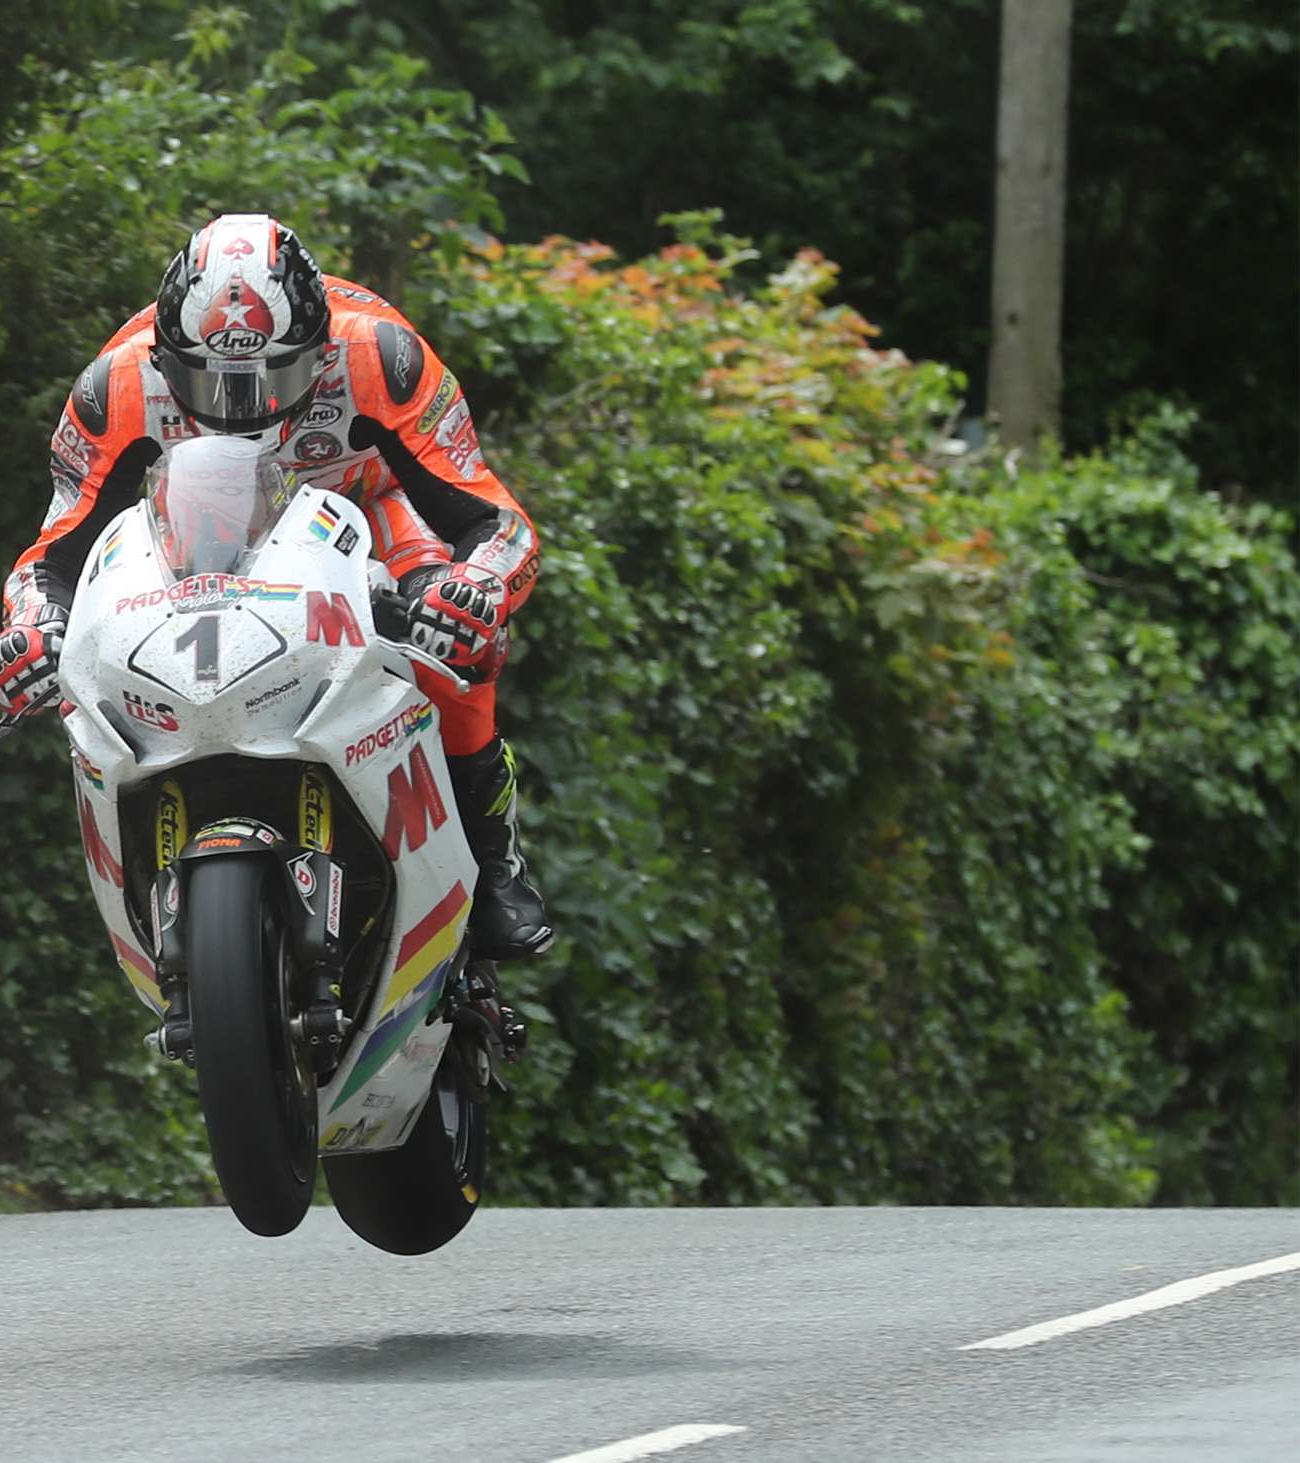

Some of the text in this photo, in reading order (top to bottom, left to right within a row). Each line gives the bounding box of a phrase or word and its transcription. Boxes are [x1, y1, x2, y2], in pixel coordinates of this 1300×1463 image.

[211, 334, 260, 350] Arai
[115, 573, 254, 614] PADGETT'S
[509, 554, 540, 594] OND
[175, 616, 221, 682] 1
[245, 677, 301, 709] Northbank
